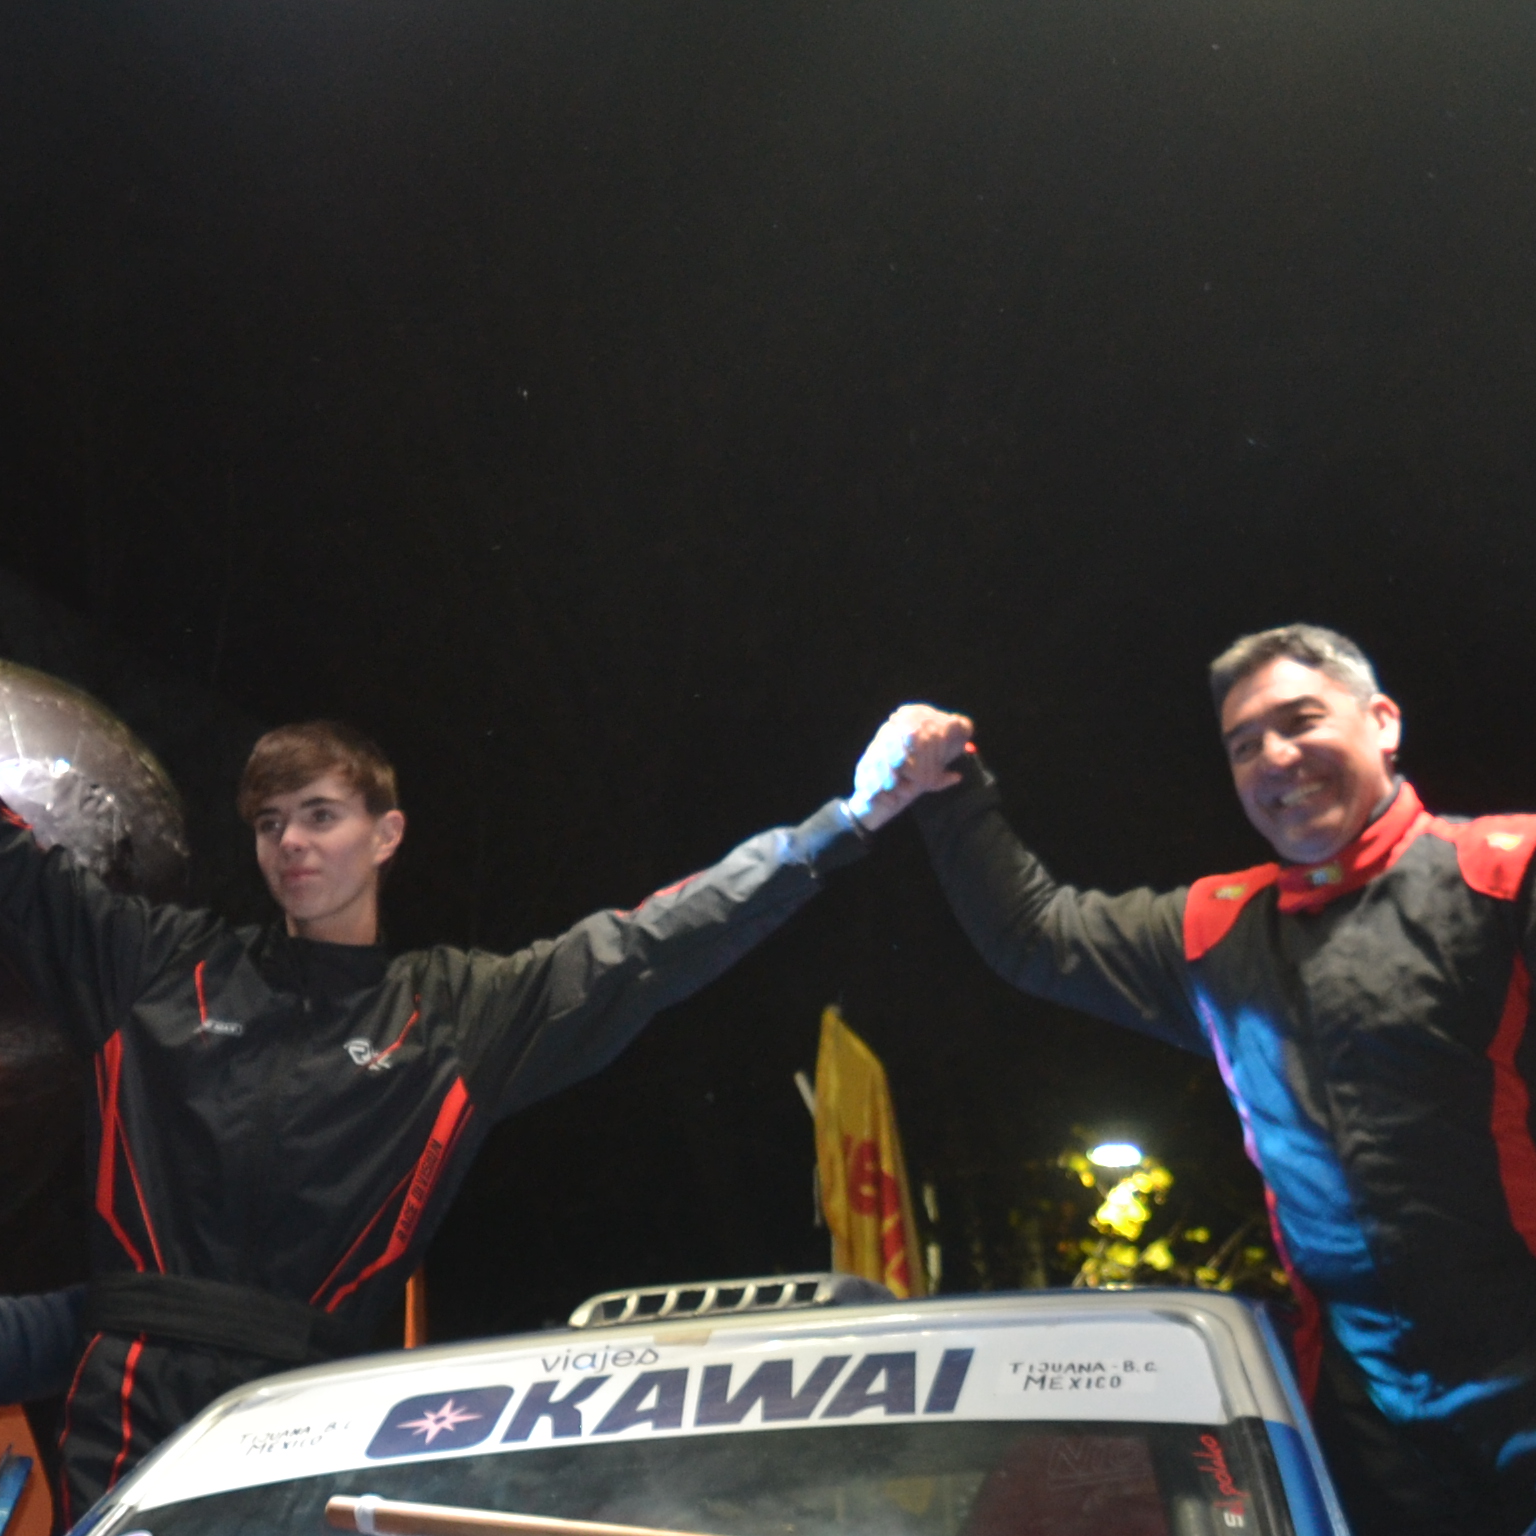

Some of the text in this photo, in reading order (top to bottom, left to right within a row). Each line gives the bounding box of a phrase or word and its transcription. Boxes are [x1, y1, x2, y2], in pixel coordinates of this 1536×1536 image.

[542, 1344, 661, 1374] viajes
[1009, 1360, 1106, 1374] TIJUANA
[1022, 1374, 1123, 1392] MEXICO
